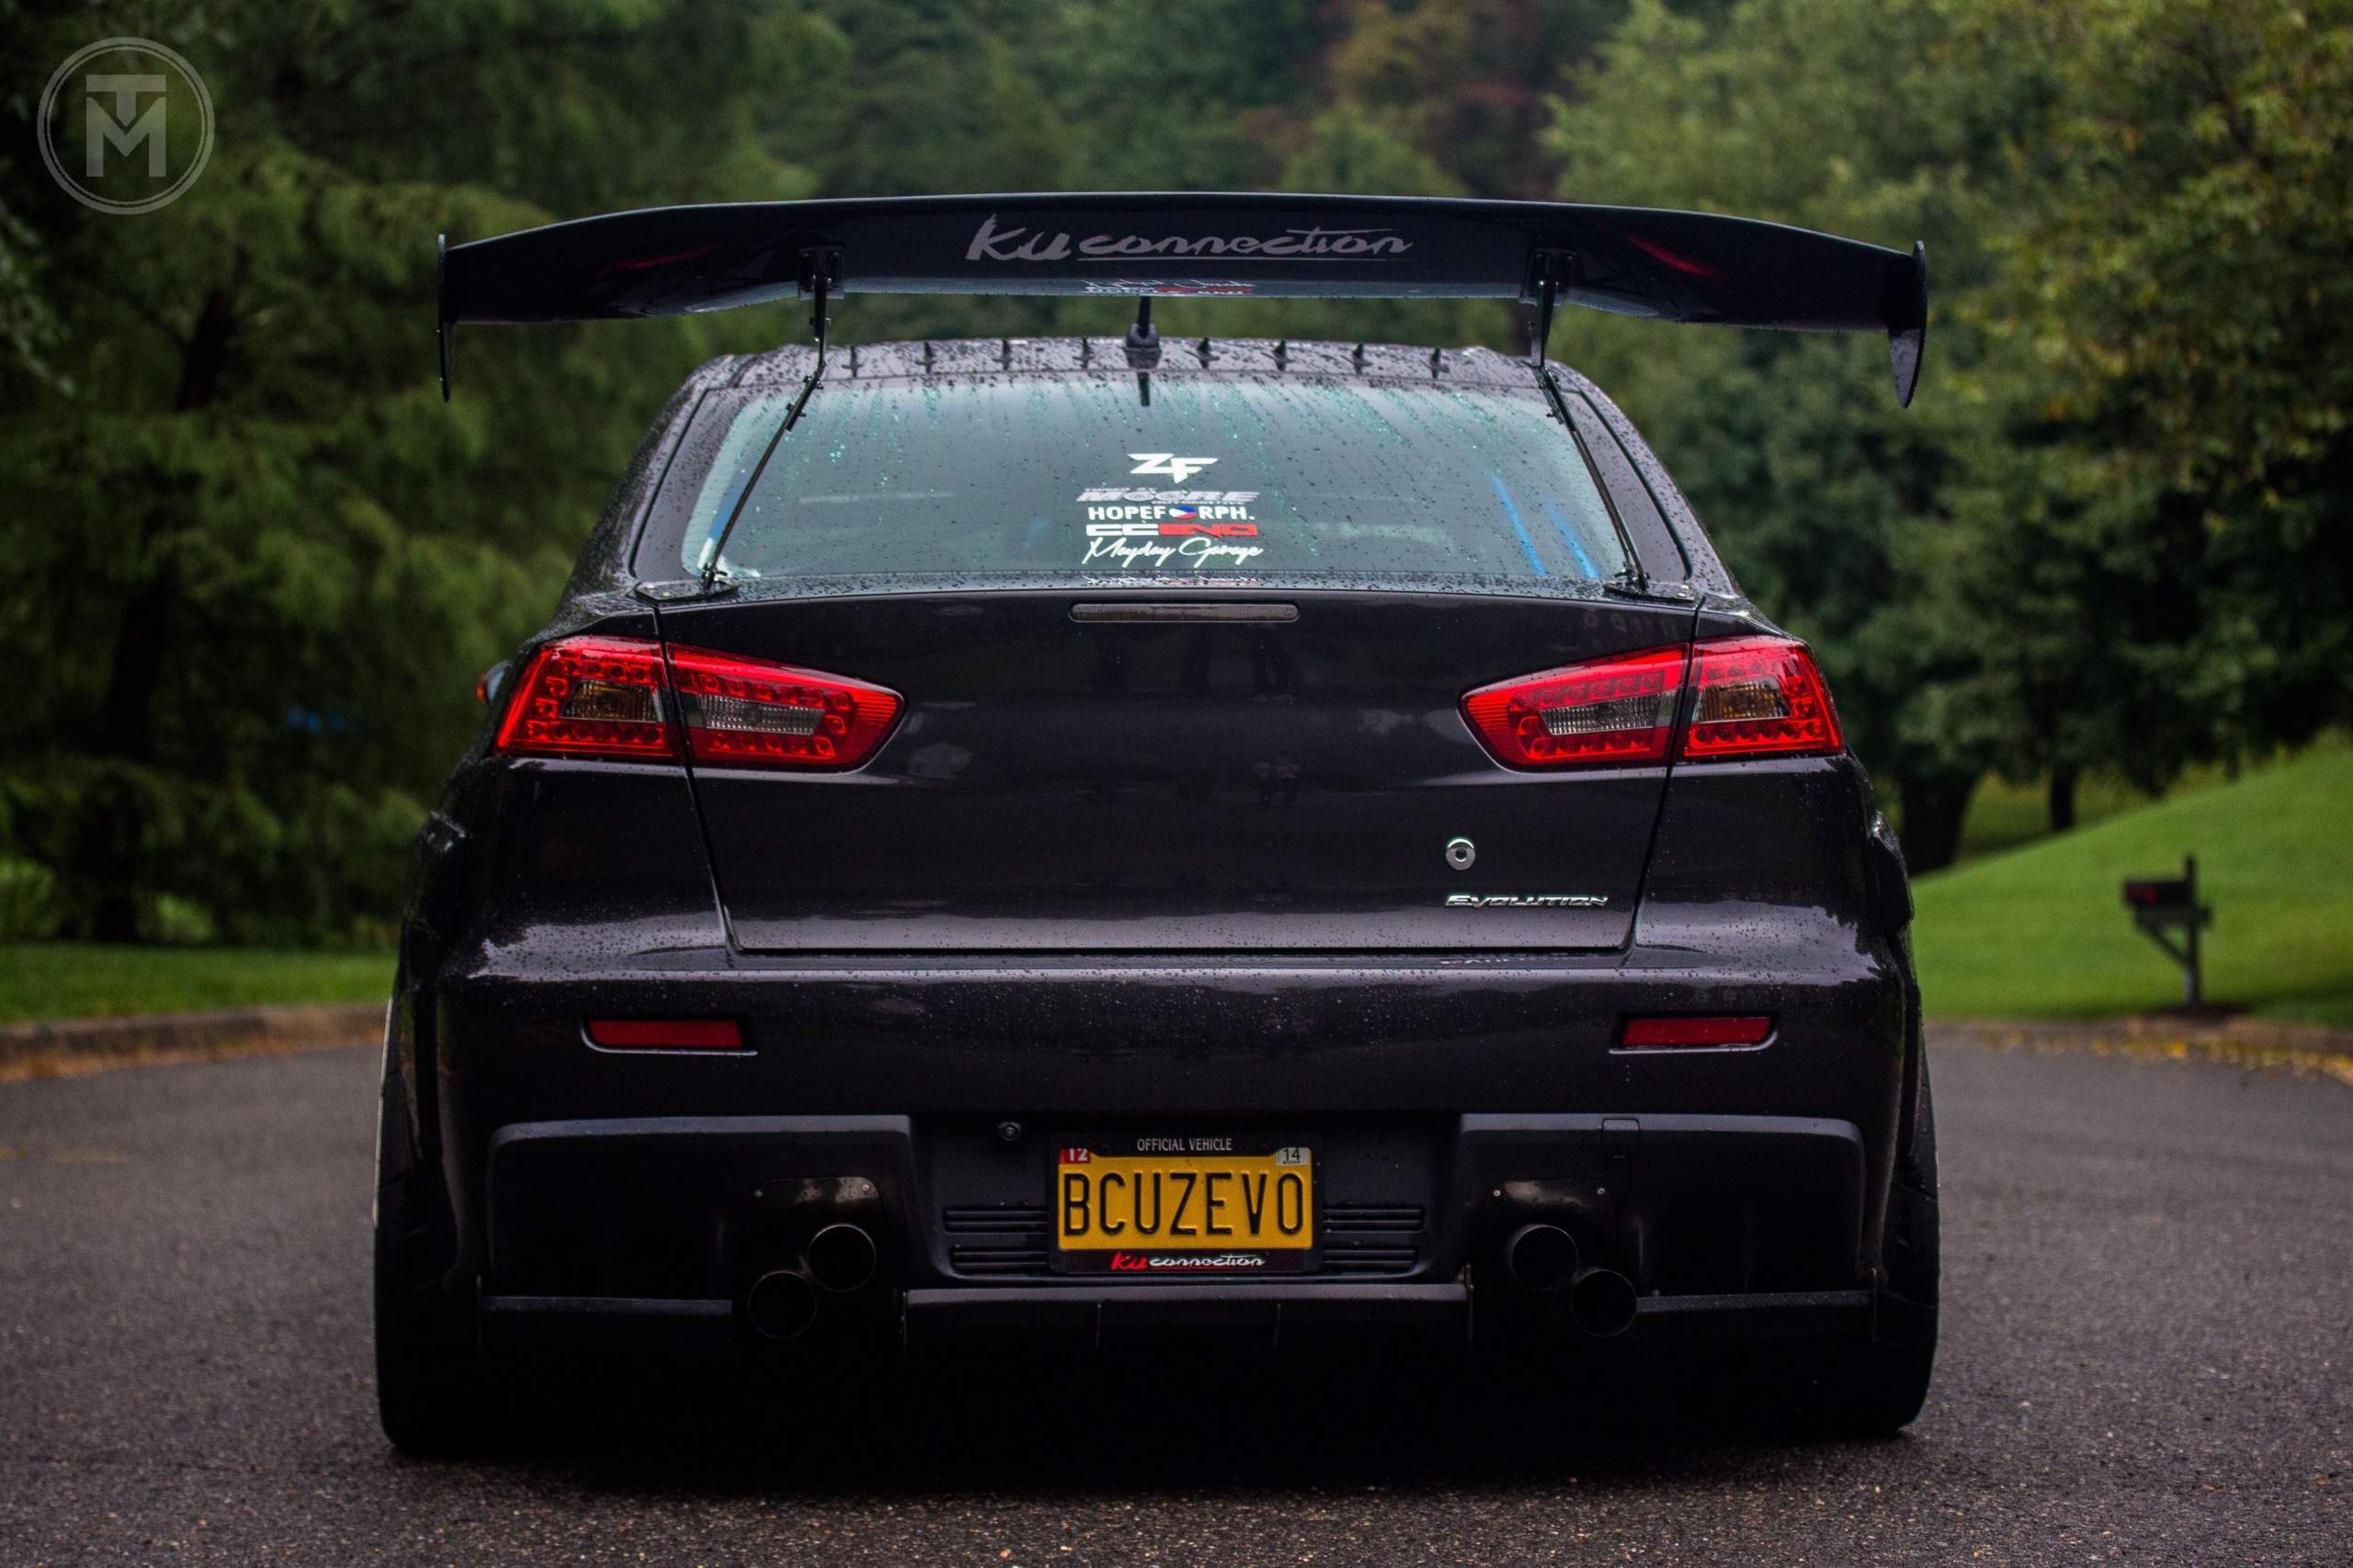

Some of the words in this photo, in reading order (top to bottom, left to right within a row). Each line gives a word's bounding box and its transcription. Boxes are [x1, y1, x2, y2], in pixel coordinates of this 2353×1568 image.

[1177, 537, 1265, 569] Garage
[1444, 894, 1608, 908] EVOLUTION
[1136, 1138, 1186, 1152] OFFICIAL
[1188, 1138, 1233, 1151] VEHICLE
[1069, 1147, 1088, 1162] 12
[1282, 1147, 1302, 1161] 14
[1063, 1171, 1303, 1236] BCUZEVO
